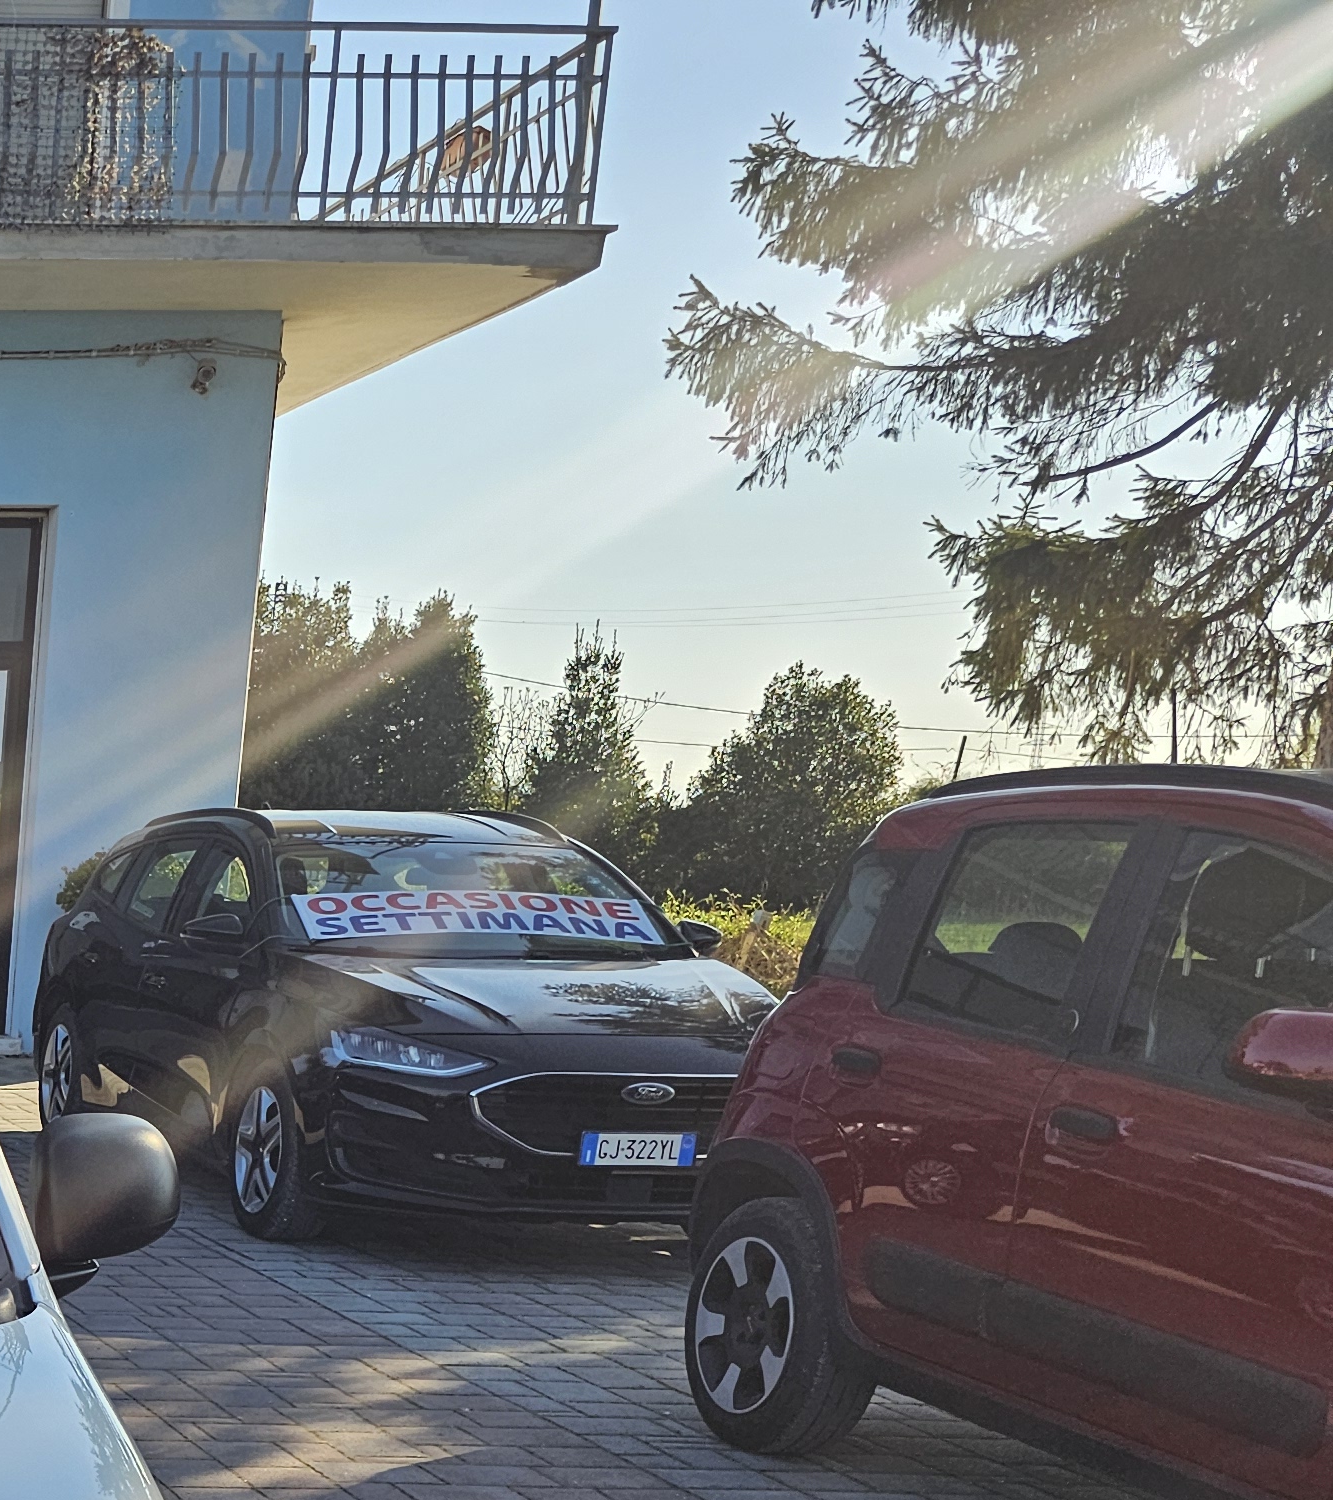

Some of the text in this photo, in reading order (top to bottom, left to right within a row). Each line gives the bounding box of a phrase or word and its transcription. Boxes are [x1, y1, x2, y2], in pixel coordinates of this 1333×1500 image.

[308, 891, 640, 922] OCCASIONE
[315, 910, 654, 942] SETTIMANA
[598, 1140, 621, 1160] GJ
[624, 1139, 678, 1161] 322YL
